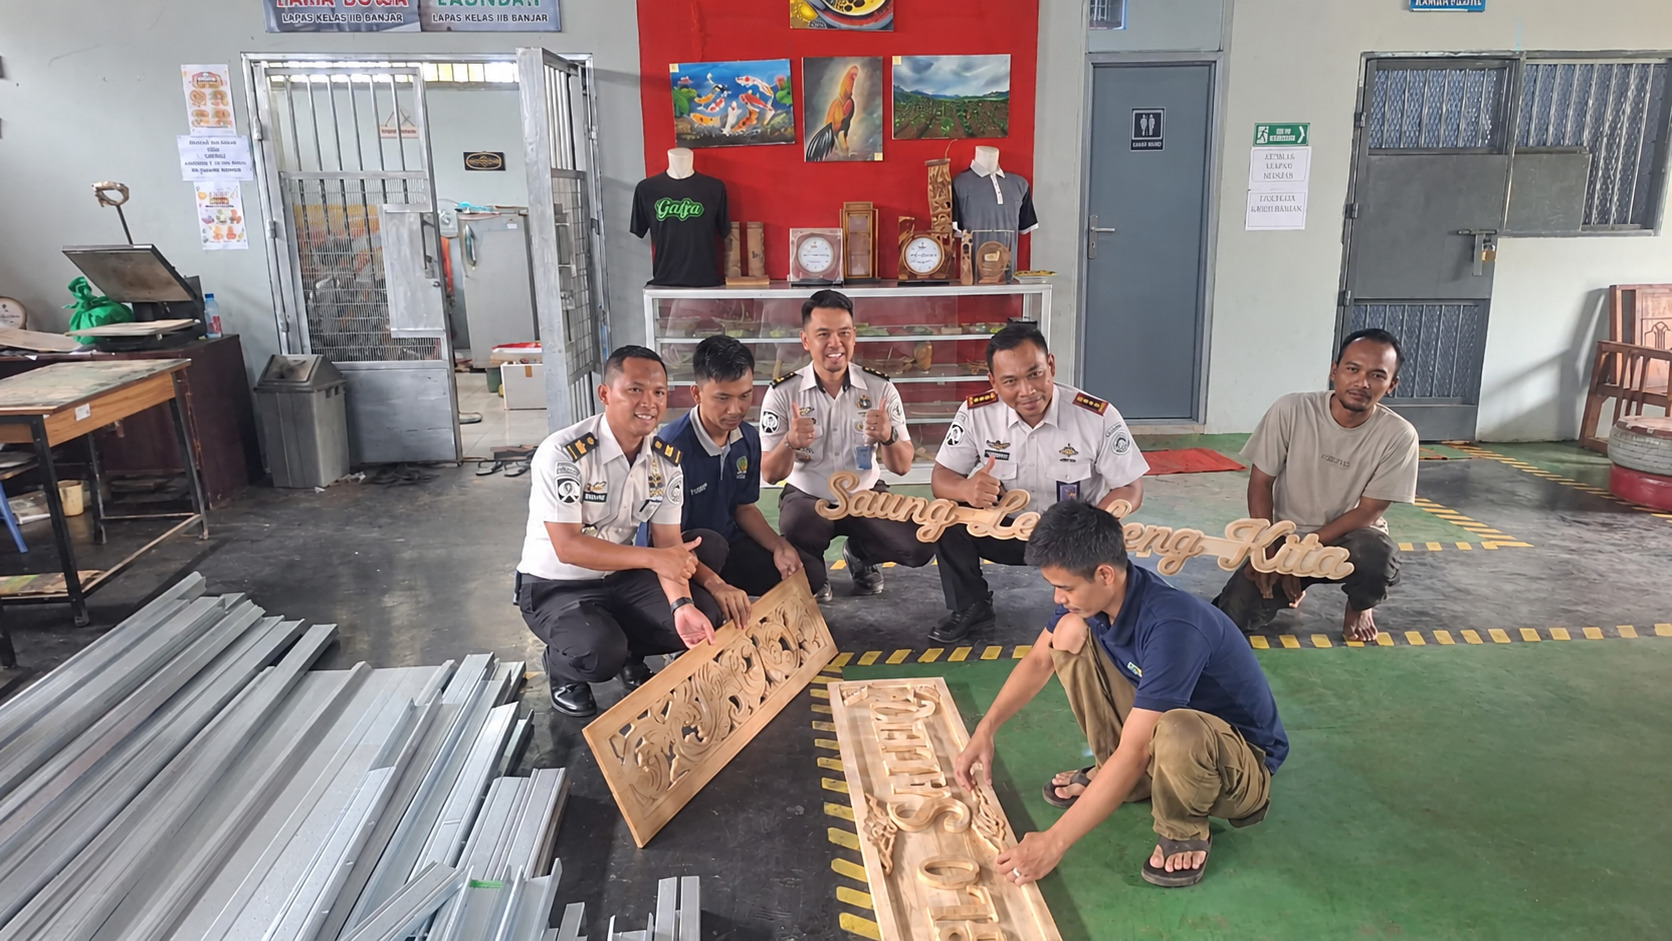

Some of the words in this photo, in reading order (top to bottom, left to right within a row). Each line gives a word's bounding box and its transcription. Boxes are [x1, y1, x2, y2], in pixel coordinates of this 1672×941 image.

[282, 13, 314, 23] LAPAS
[316, 13, 346, 23] KELAS
[364, 13, 403, 23] BANJAR
[432, 14, 462, 22] LAPAS
[464, 14, 494, 22] KELAS
[511, 14, 548, 22] BANJAR
[815, 471, 958, 543] Saung
[1217, 518, 1355, 580] Kita
